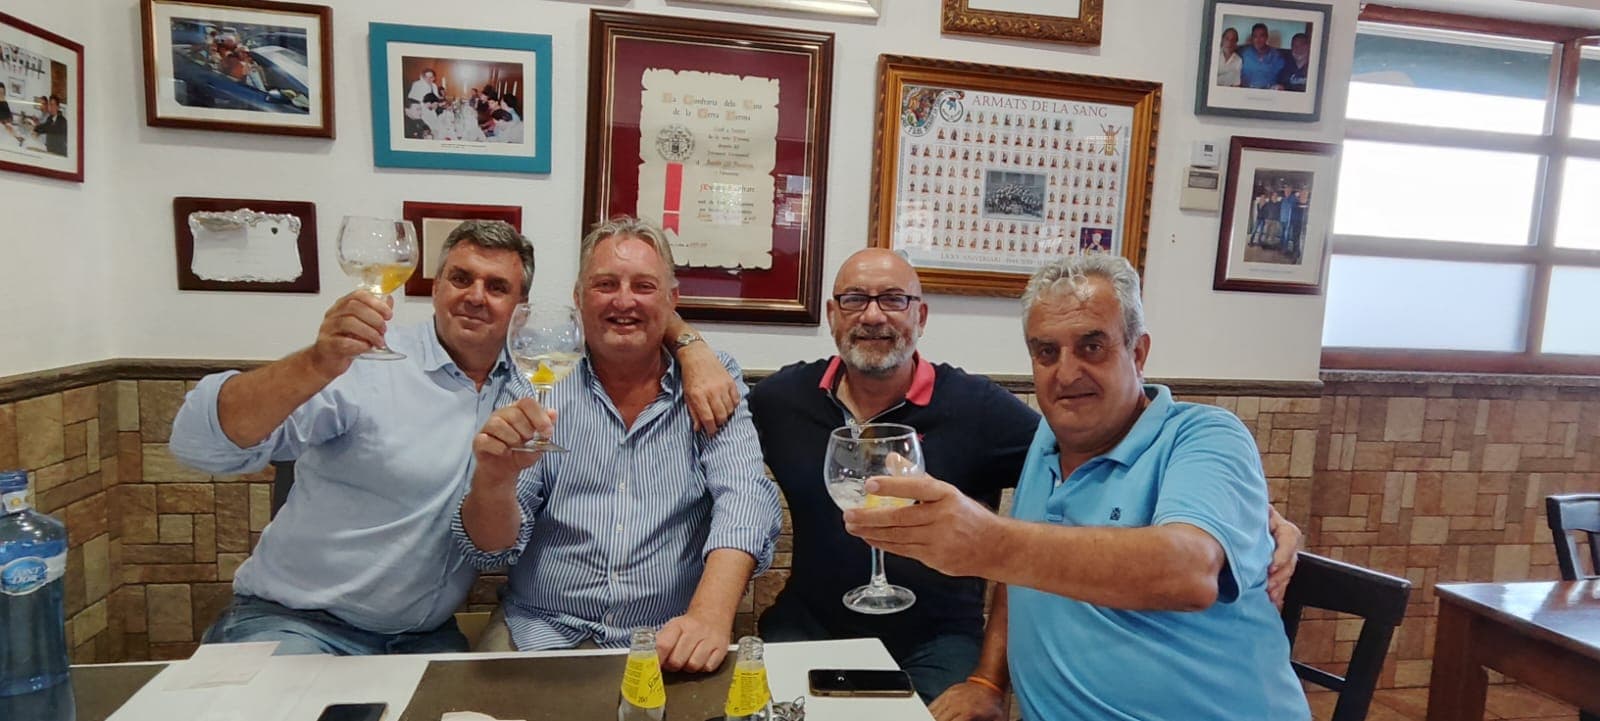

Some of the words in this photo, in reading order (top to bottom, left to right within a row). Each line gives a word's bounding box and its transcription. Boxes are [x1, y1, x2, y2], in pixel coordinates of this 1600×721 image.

[972, 96, 1027, 110] ARMATS
[1032, 100, 1048, 112] DE
[1053, 103, 1069, 114] LA
[1073, 105, 1107, 118] SANG
